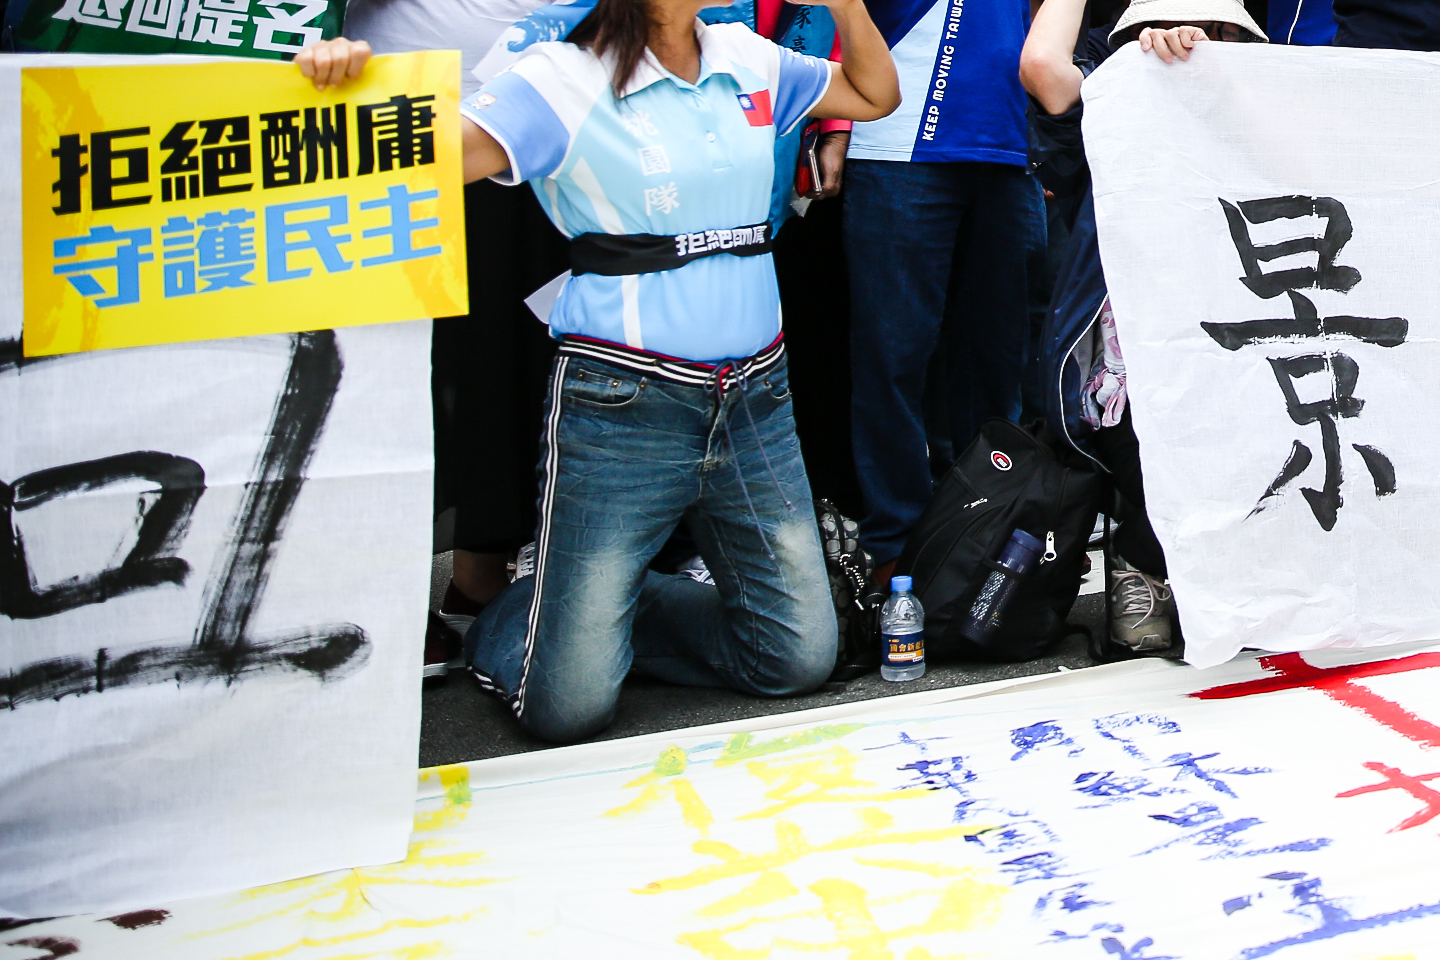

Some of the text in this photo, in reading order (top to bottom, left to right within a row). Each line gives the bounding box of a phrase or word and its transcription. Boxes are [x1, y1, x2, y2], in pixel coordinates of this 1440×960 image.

[922, 105, 940, 141] KEEP
[932, 44, 955, 102] MOVING
[51, 93, 436, 216] 拒絕酬庸
[622, 108, 681, 217] 桃園隊
[53, 184, 442, 309] 守護民主
